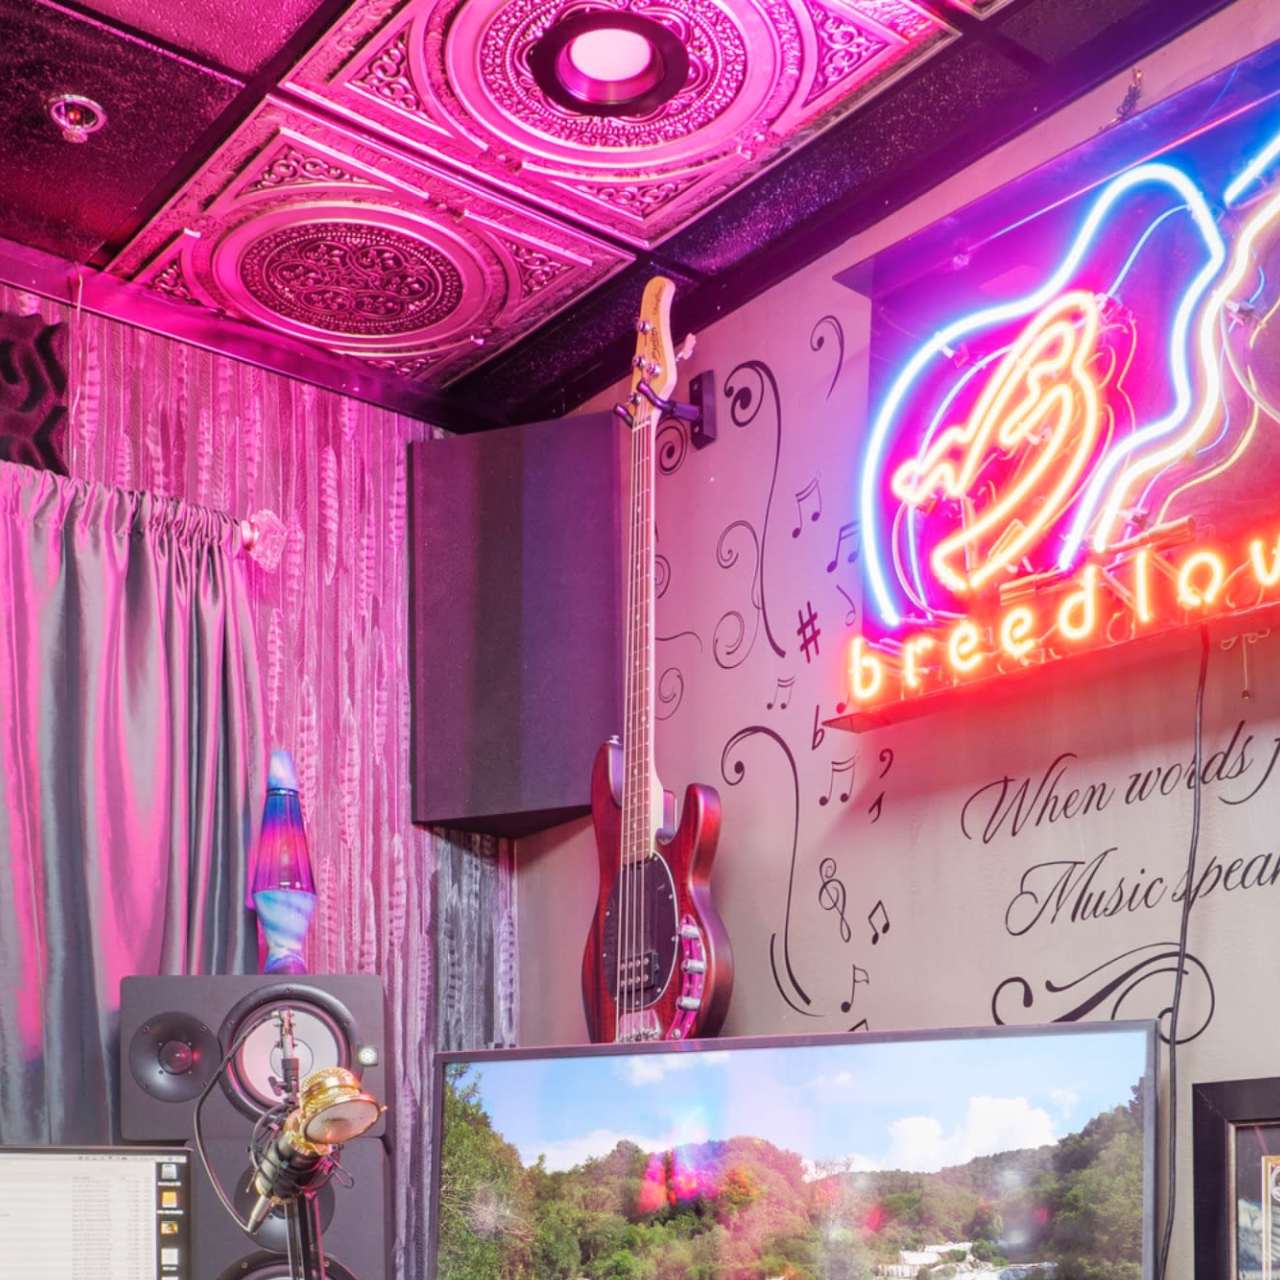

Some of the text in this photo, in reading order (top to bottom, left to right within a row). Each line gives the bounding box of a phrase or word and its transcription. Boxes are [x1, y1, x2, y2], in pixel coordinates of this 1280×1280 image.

[960, 752, 1117, 845] When
[1123, 720, 1255, 803] words
[1005, 847, 1167, 936] Music
